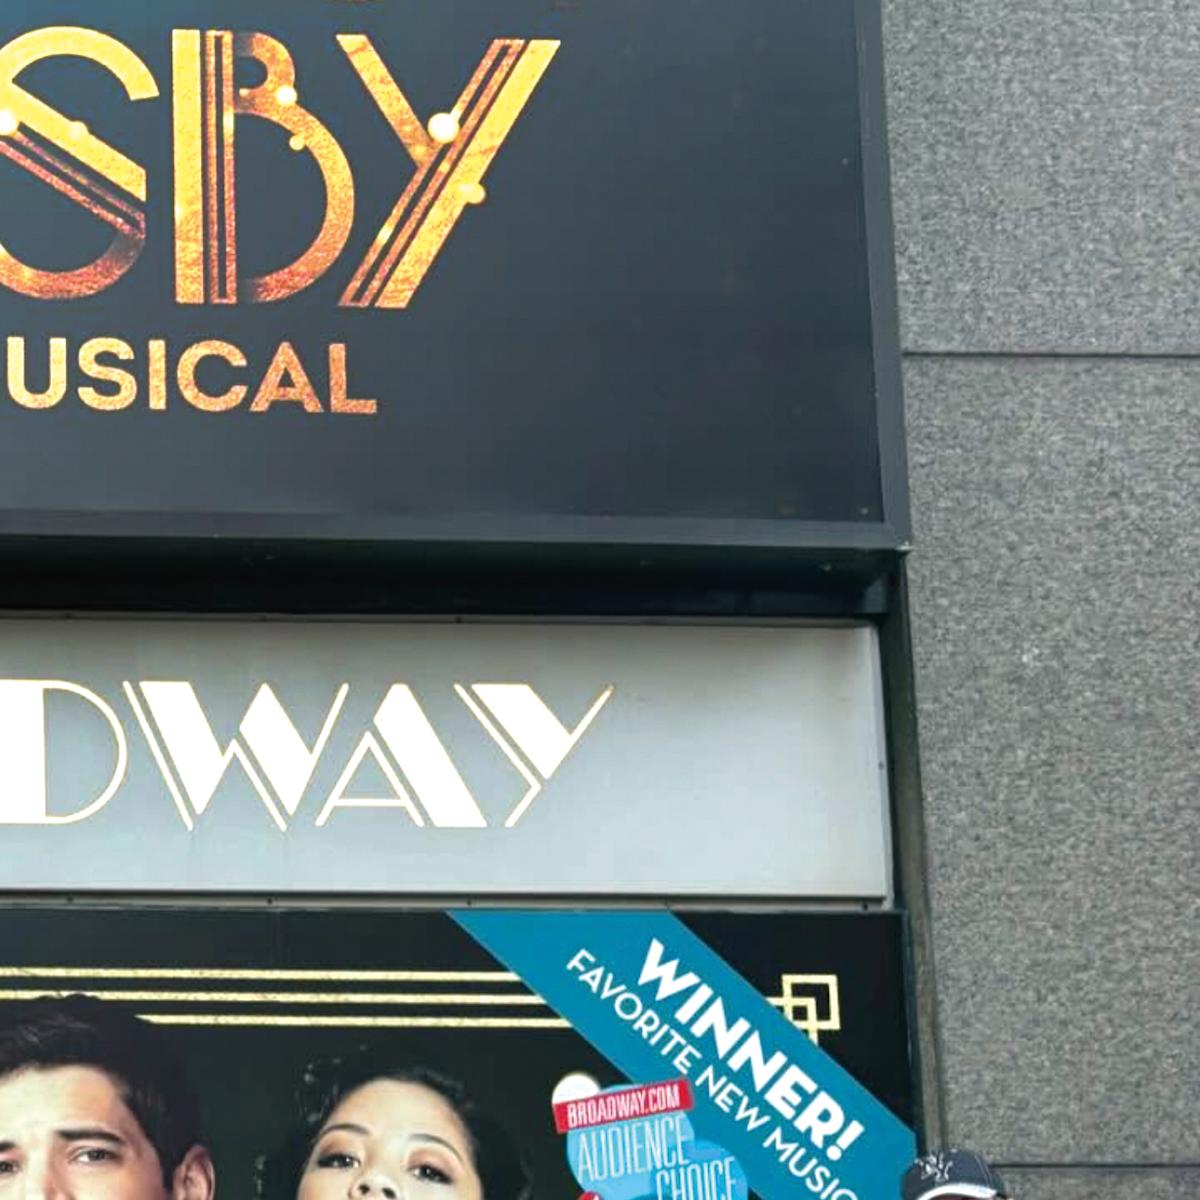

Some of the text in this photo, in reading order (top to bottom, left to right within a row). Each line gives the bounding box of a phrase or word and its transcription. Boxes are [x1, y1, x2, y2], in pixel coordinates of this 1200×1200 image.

[566, 949, 701, 1075] FAVORITE
[695, 1065, 768, 1132] NEW
[637, 938, 864, 1162] WINNER!
[567, 1083, 681, 1128] BROADWAY.COM
[577, 1115, 690, 1182] AUDIENCE
